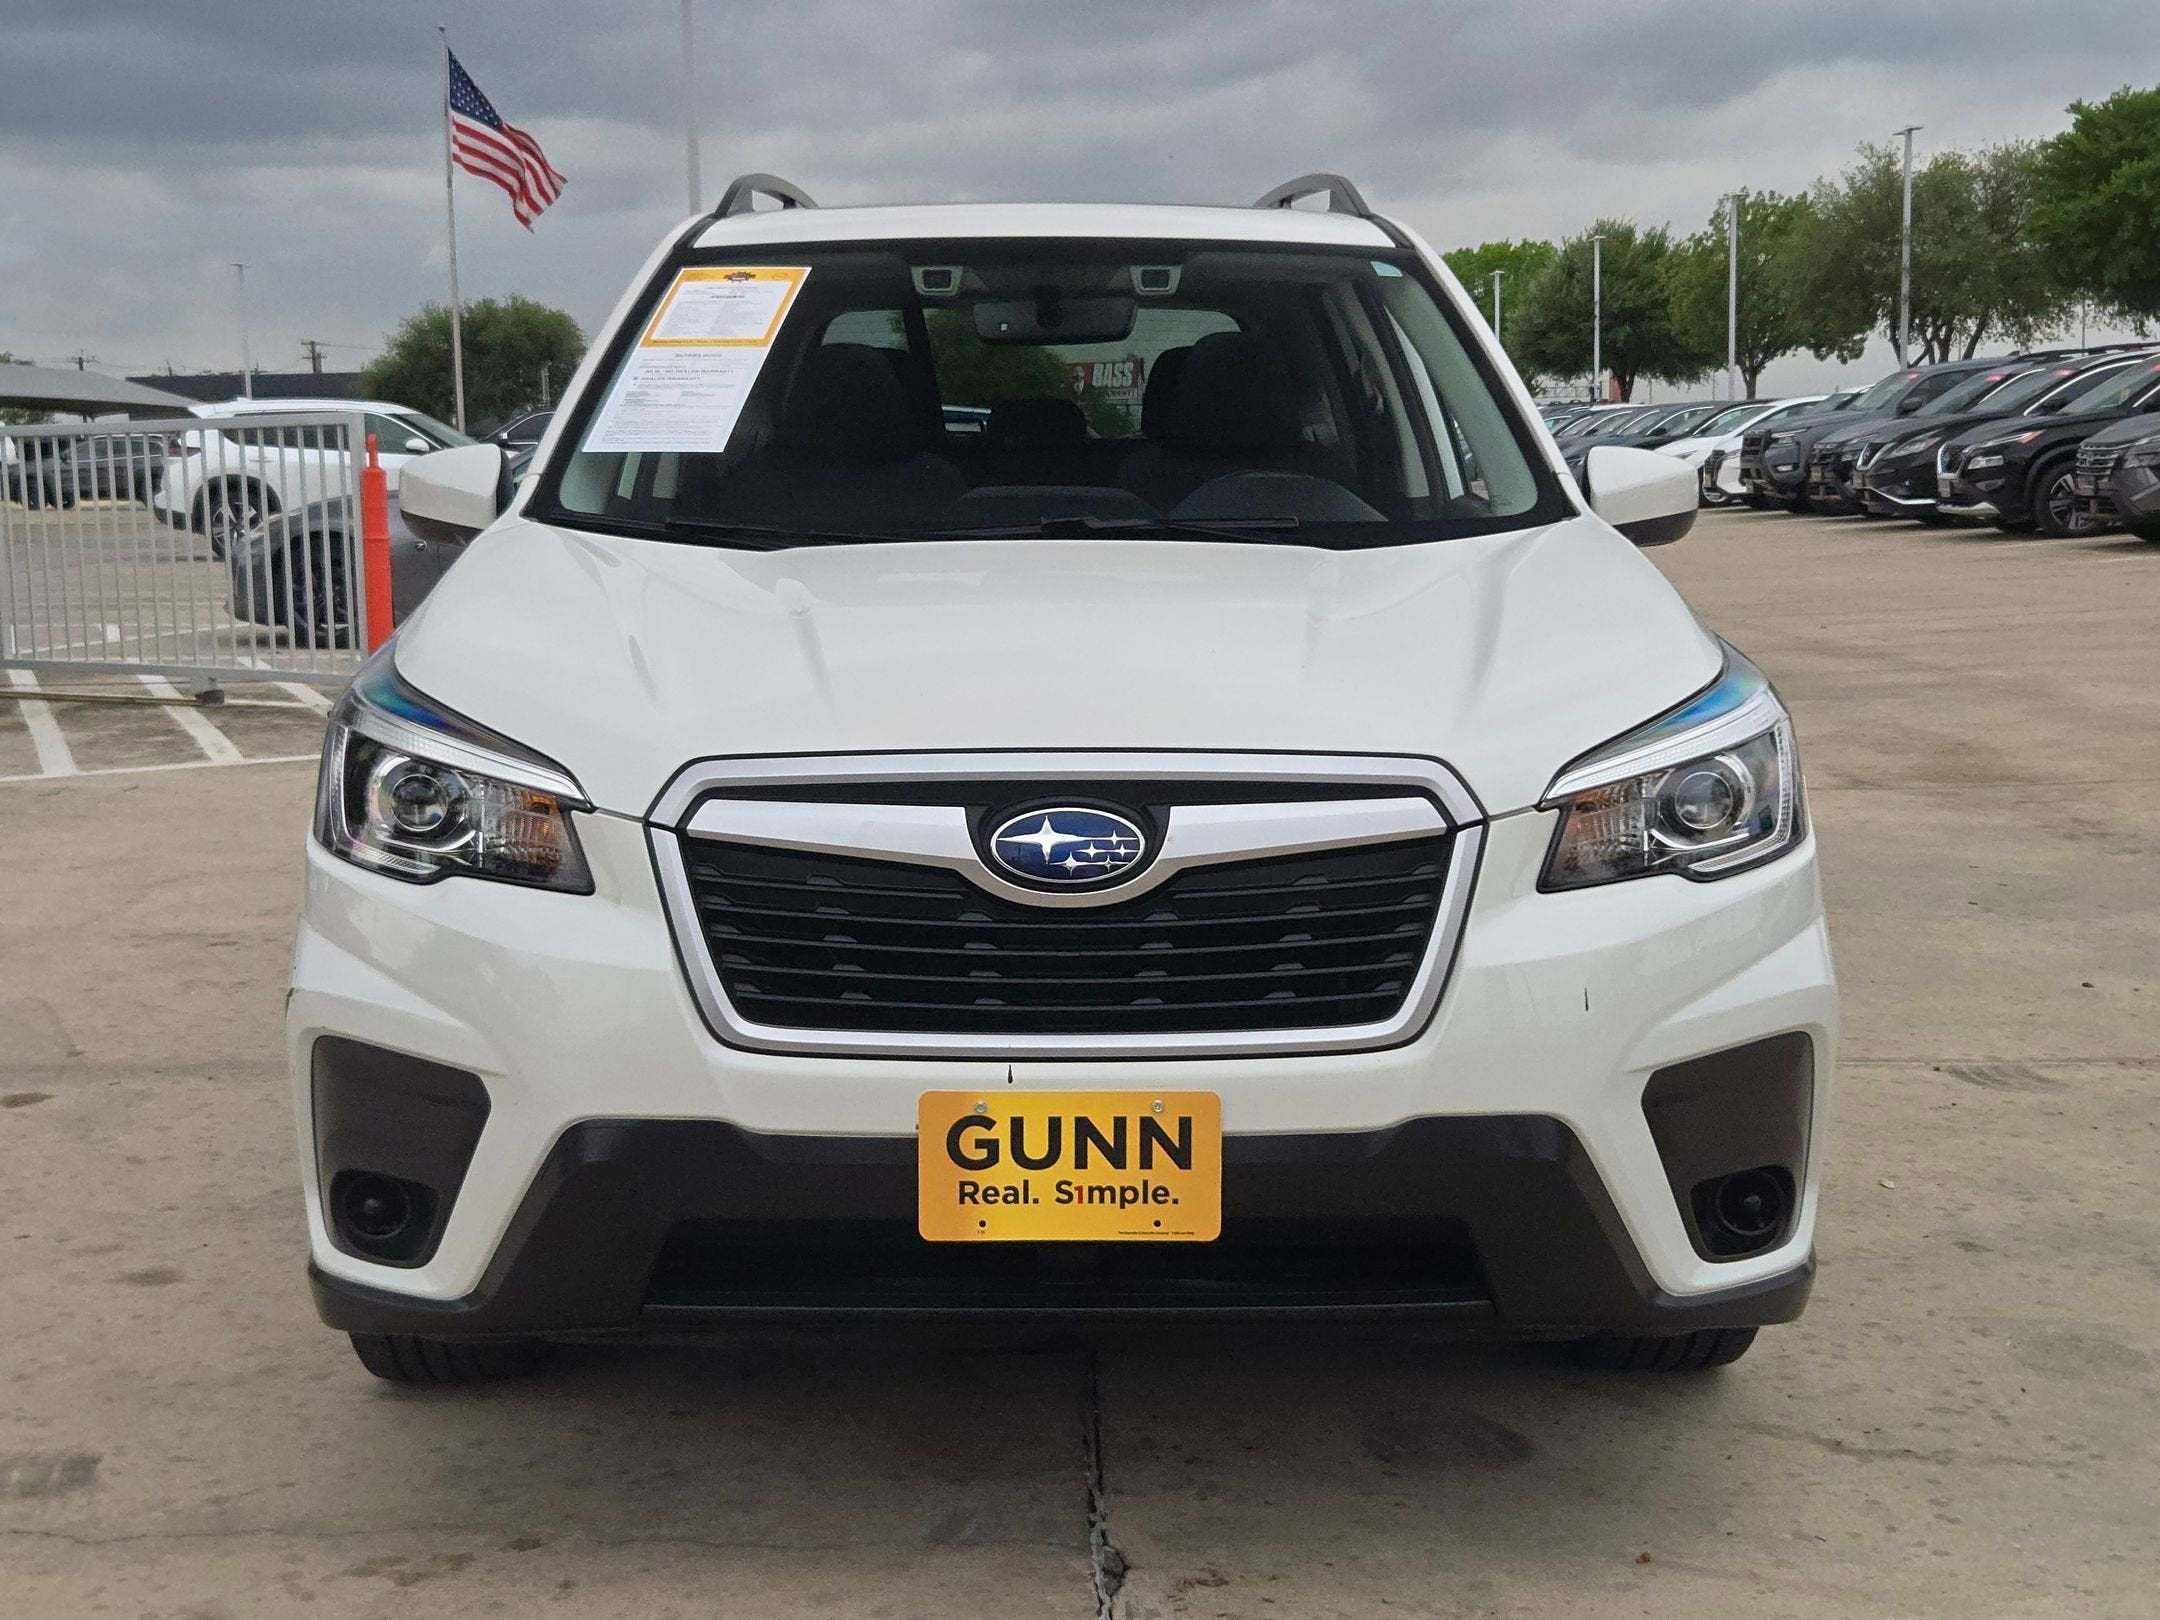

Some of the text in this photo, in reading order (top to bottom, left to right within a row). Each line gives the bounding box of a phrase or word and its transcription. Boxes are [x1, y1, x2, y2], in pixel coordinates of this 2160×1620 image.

[1092, 362, 1134, 388] BASS
[946, 1114, 1193, 1171] GUNN
[959, 1179, 1040, 1205] Real.
